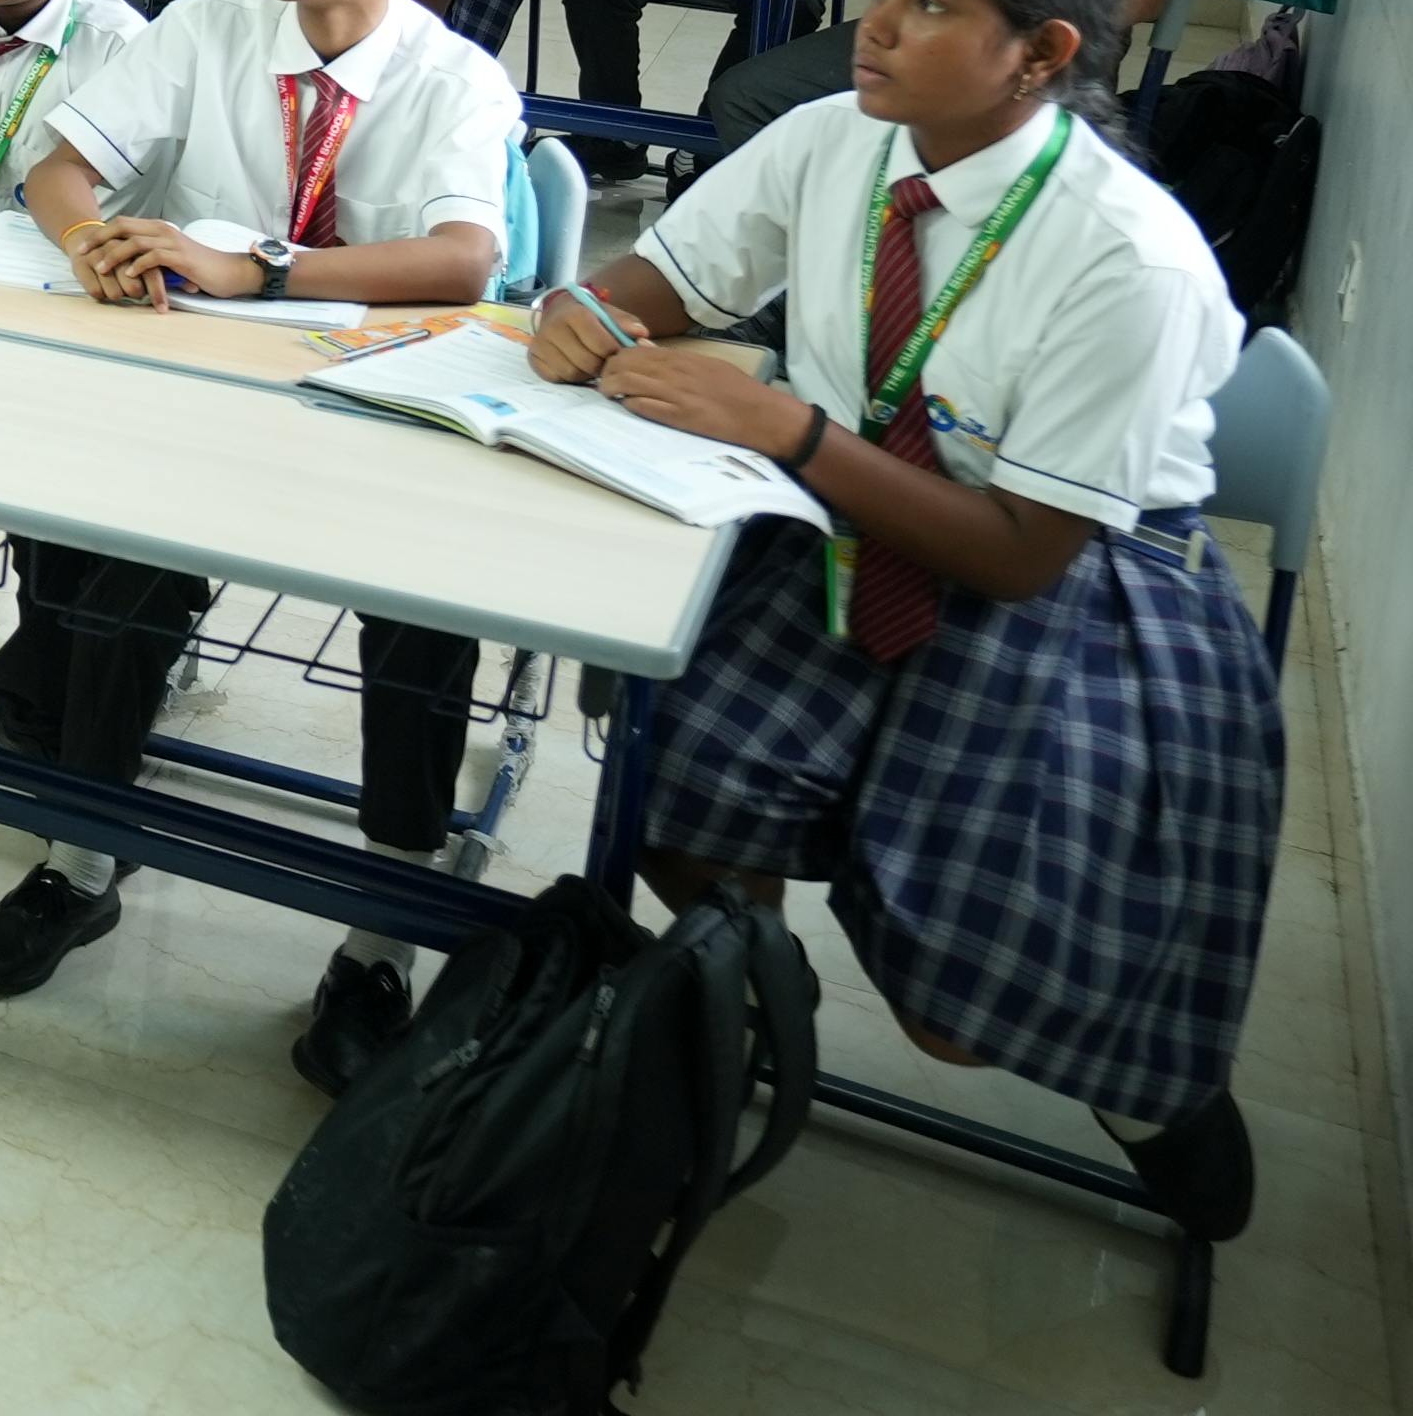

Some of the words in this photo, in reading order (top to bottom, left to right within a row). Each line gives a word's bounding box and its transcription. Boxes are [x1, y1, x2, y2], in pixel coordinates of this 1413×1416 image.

[295, 156, 325, 223] GURUKULAM
[881, 364, 906, 393] THE
[896, 286, 956, 368] GURUKULAM
